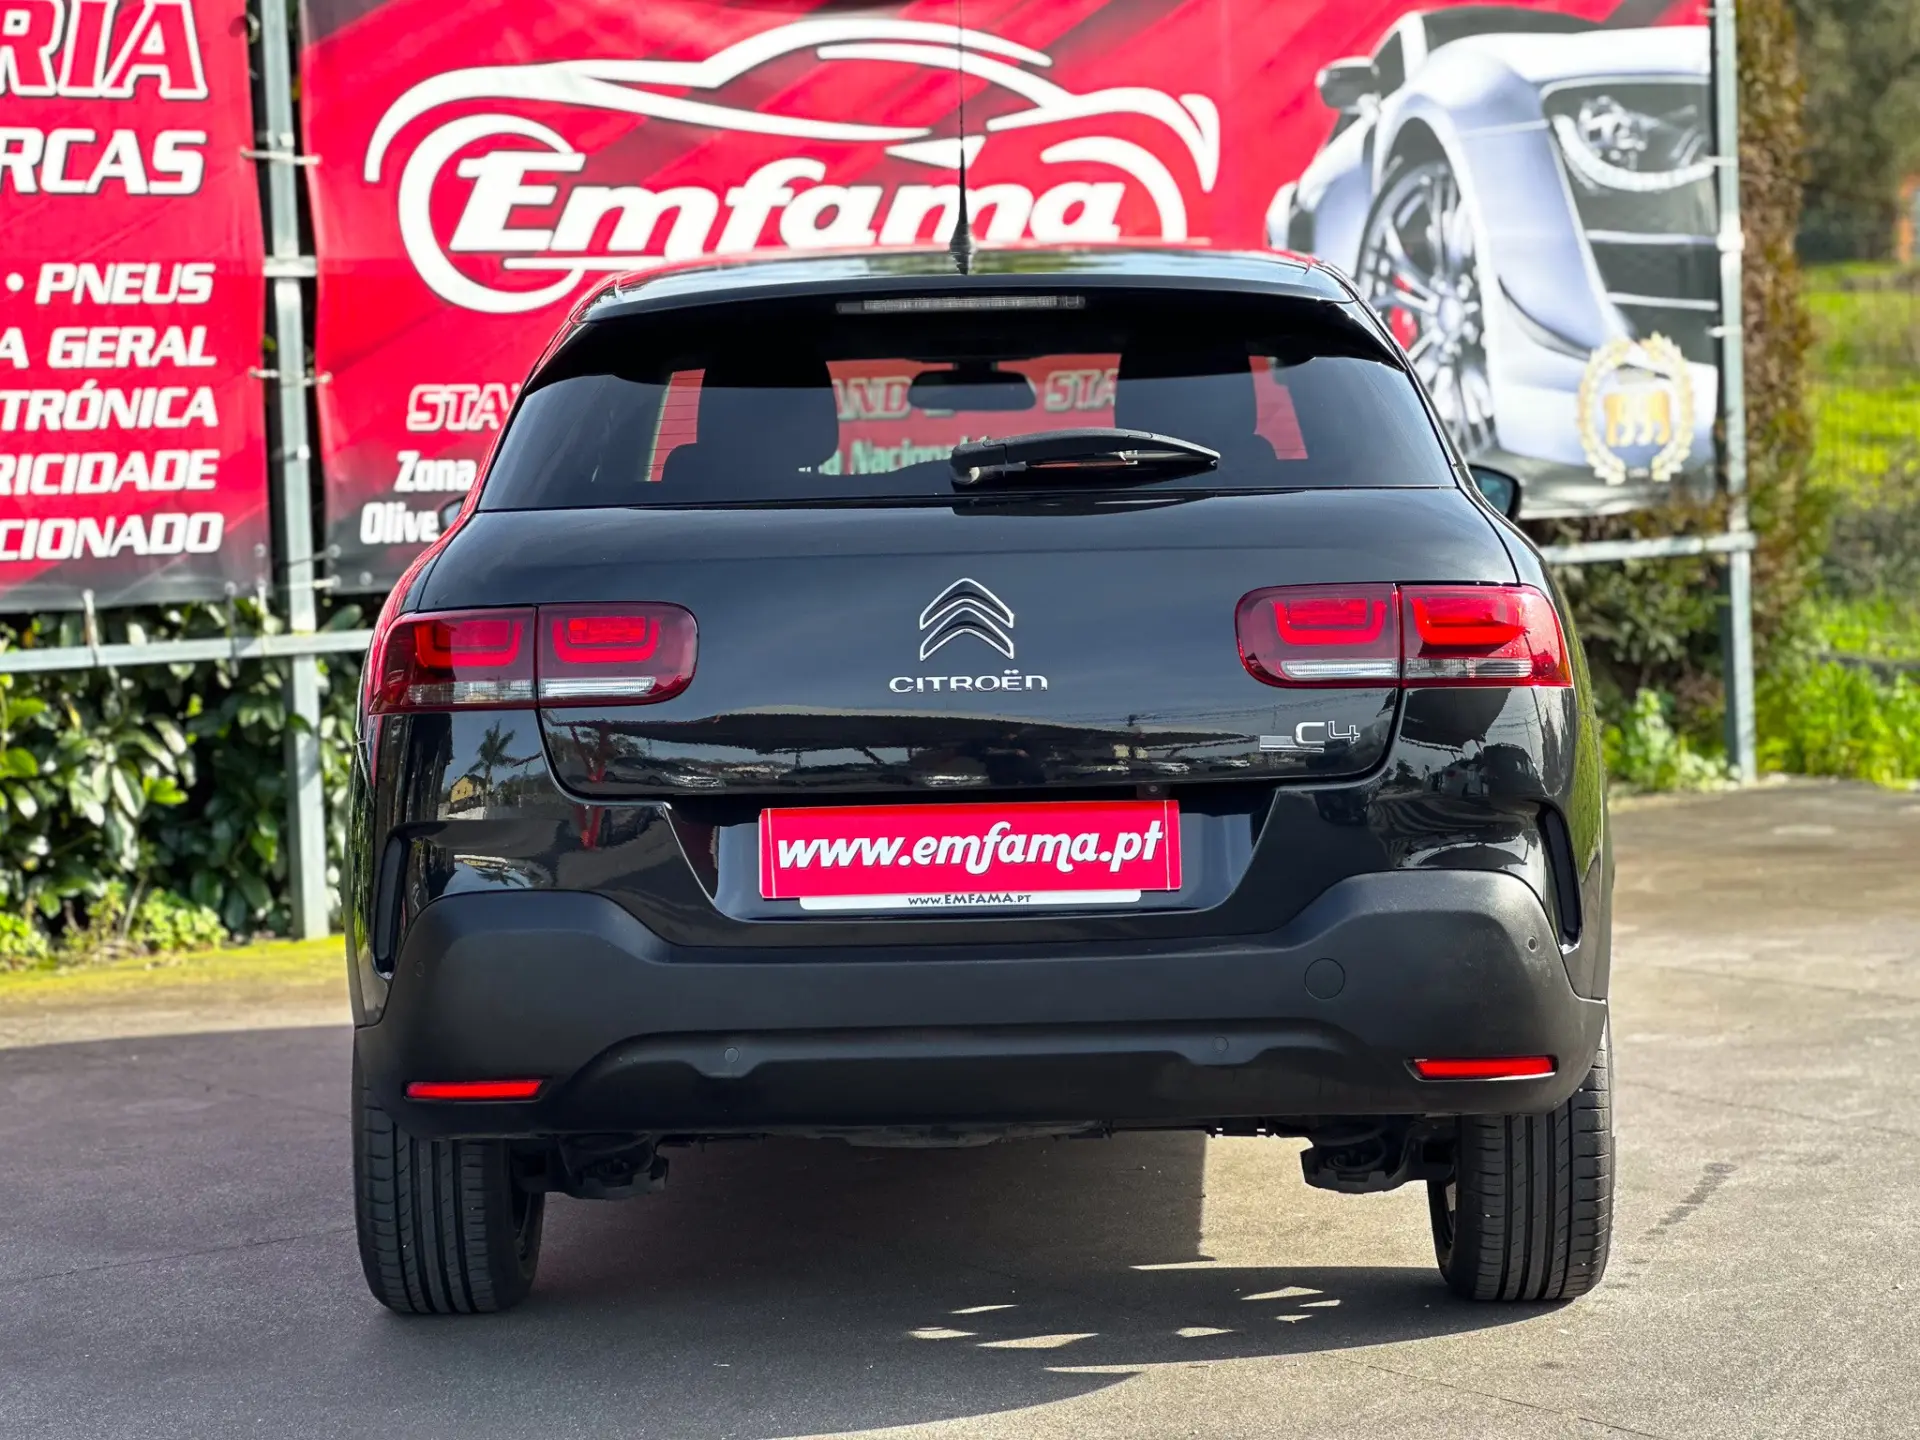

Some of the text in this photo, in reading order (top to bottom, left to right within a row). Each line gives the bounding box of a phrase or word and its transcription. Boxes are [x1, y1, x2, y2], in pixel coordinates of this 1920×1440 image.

[448, 150, 1127, 264] Emfama
[35, 262, 216, 305] PNEUS
[47, 325, 217, 369] GERAL
[0, 378, 219, 432] TRÓNICA
[406, 383, 520, 432] STA
[394, 450, 477, 493] Zona
[1295, 720, 1361, 748] C4
[777, 820, 1164, 875] www.emfama.pt
